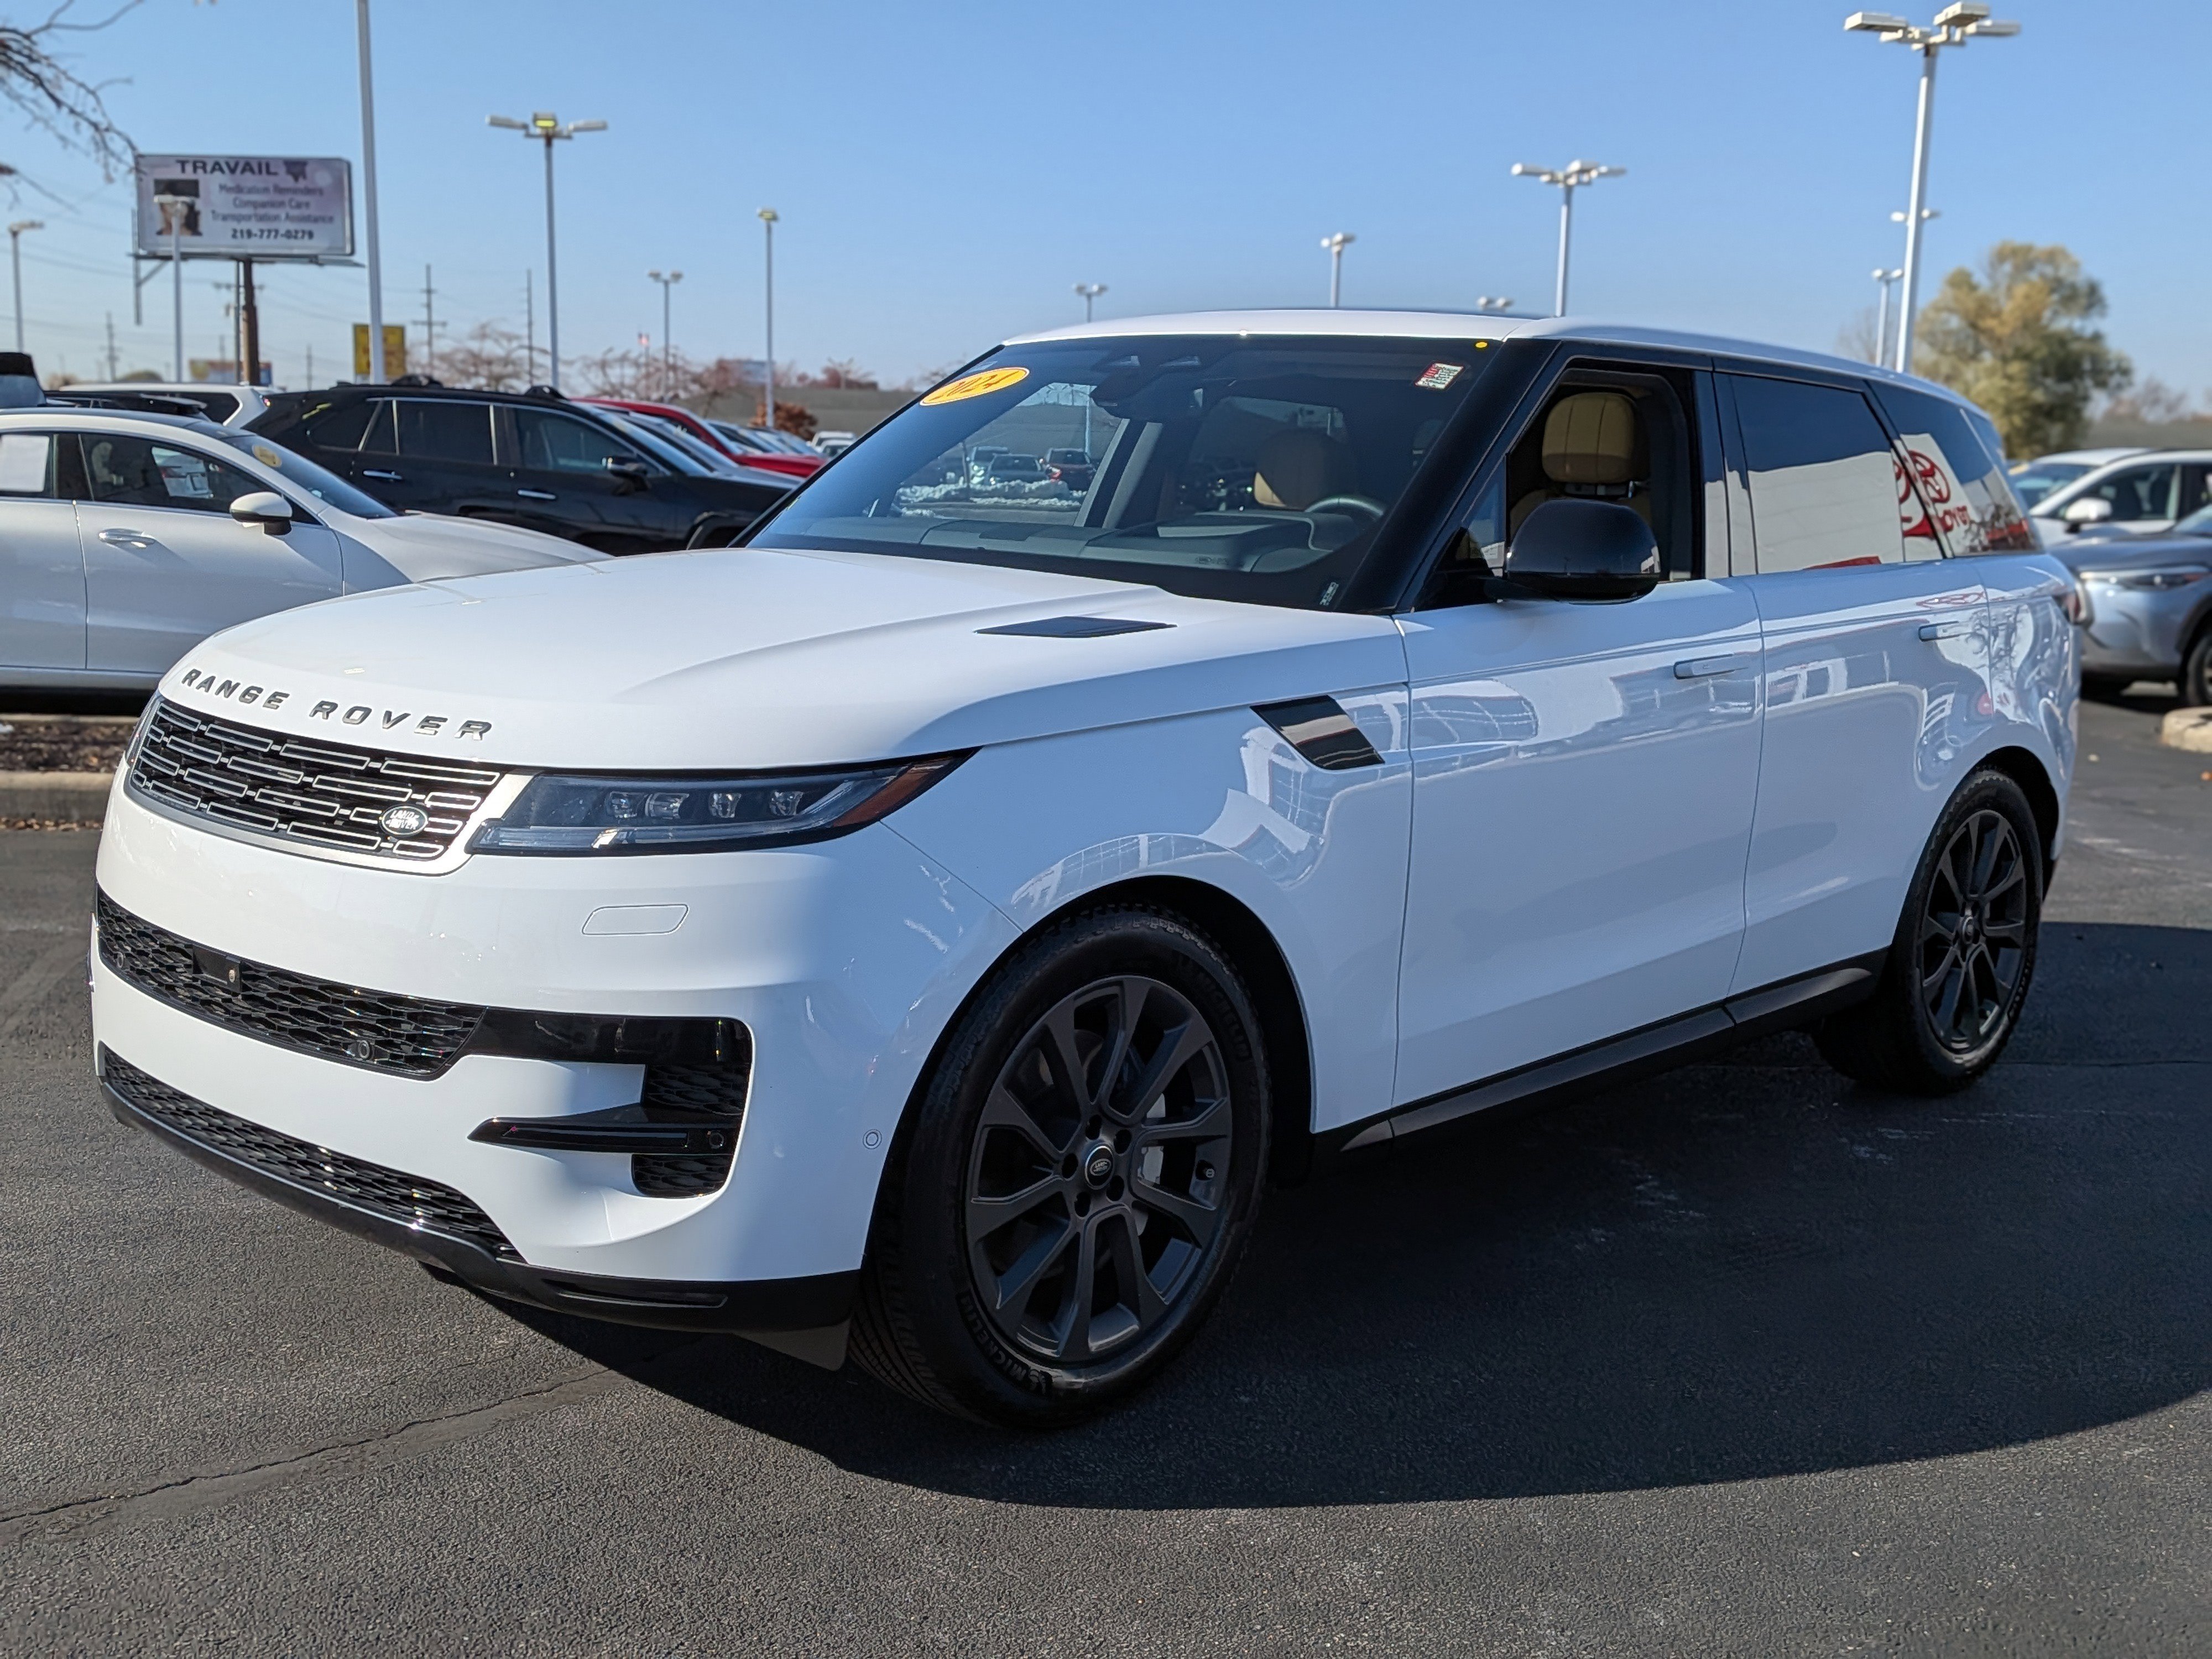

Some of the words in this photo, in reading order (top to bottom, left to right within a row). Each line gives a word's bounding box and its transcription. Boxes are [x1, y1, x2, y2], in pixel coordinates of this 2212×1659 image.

[175, 160, 279, 175] TRAVAIL
[233, 196, 286, 210] Companion
[288, 197, 311, 210] Care
[182, 669, 290, 709] RANGE
[309, 700, 493, 740] ROVER
[960, 1294, 1027, 1381] MICHELIN
